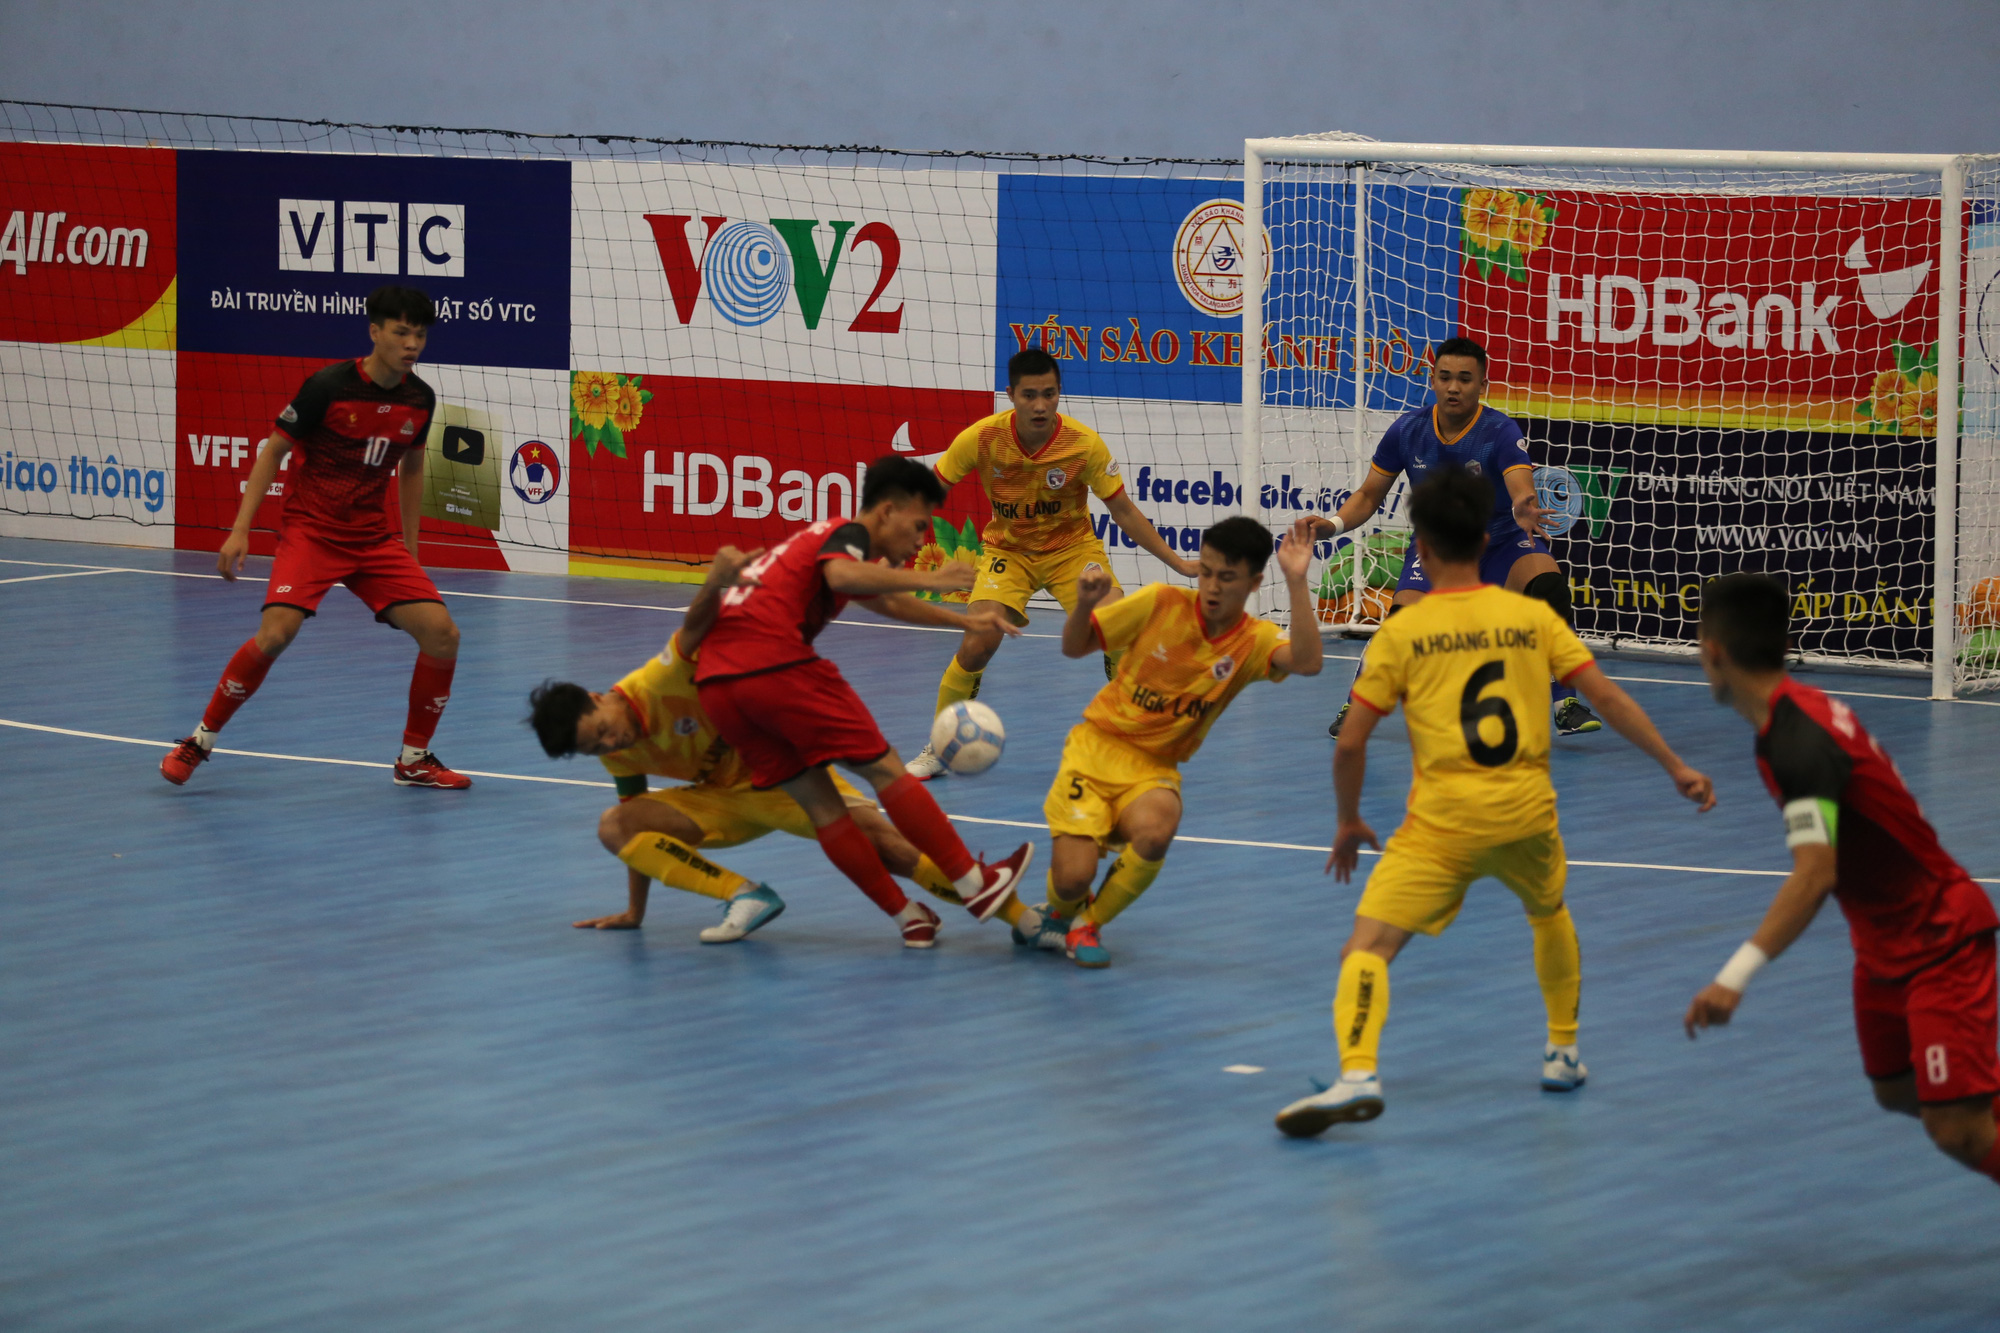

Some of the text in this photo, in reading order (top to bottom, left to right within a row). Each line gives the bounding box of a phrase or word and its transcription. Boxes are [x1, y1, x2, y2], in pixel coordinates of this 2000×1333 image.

[288, 209, 454, 267] VTC
[643, 214, 904, 334] VOV2
[211, 287, 536, 323] ĐÀI TRUYỀN HÌNH ẬT SỐ VTC
[1546, 273, 1842, 352] HDBank
[1009, 314, 1436, 376] YẾN SÀO KHÁNH HÒA
[188, 434, 249, 468] VFF
[363, 437, 390, 466] 10
[0, 451, 164, 512] iao thông
[528, 488, 542, 496] VFF
[1637, 466, 1936, 508] ĐÀI TIẾNG NÓI VIỆT NAM
[993, 500, 1062, 519] HGK LAND
[989, 557, 1007, 574] 16
[1612, 579, 1666, 609] TIN
[1791, 578, 1831, 618] ẤP
[1843, 580, 1918, 624] DẪN
[1496, 627, 1537, 650] LONG
[1132, 685, 1169, 713] HGK
[1461, 660, 1518, 767] 6
[1068, 777, 1084, 800] 5
[1925, 1044, 1948, 1084] 8
